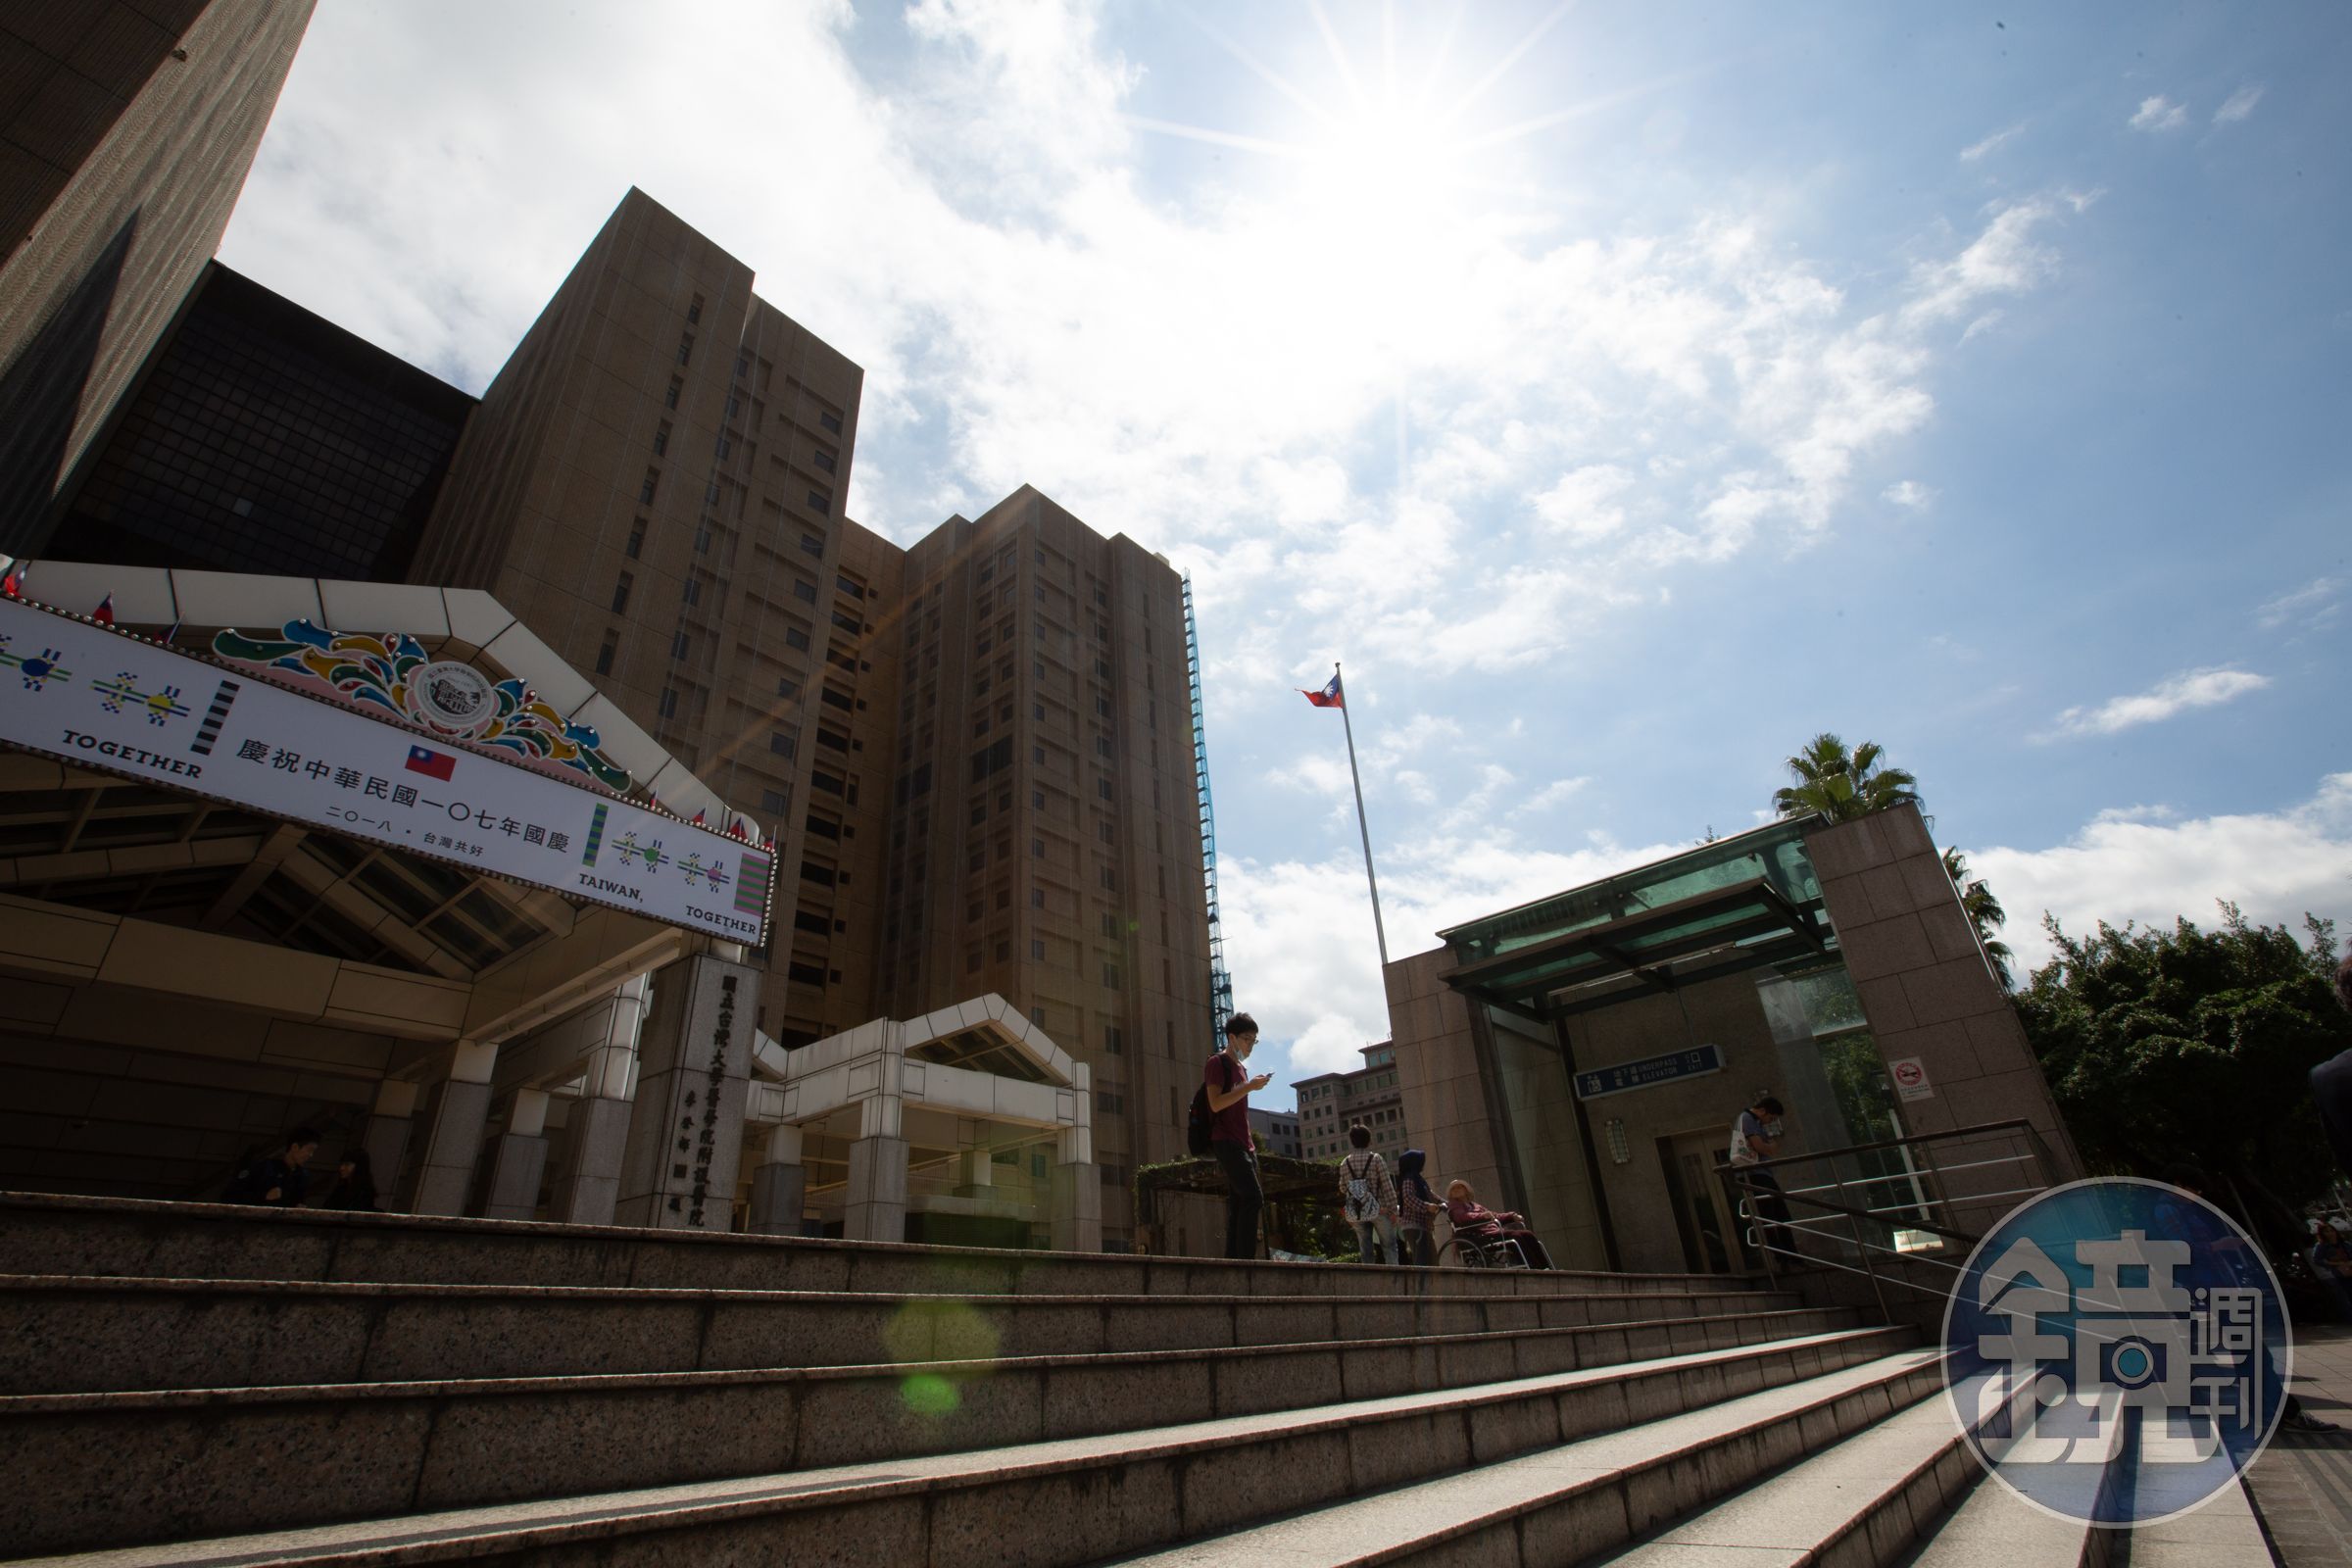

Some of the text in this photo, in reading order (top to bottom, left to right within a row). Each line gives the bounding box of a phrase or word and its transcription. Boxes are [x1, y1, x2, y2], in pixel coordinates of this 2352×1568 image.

[62, 729, 203, 780] TOGETHER
[579, 873, 757, 935] TAIWAN, TOGETHER
